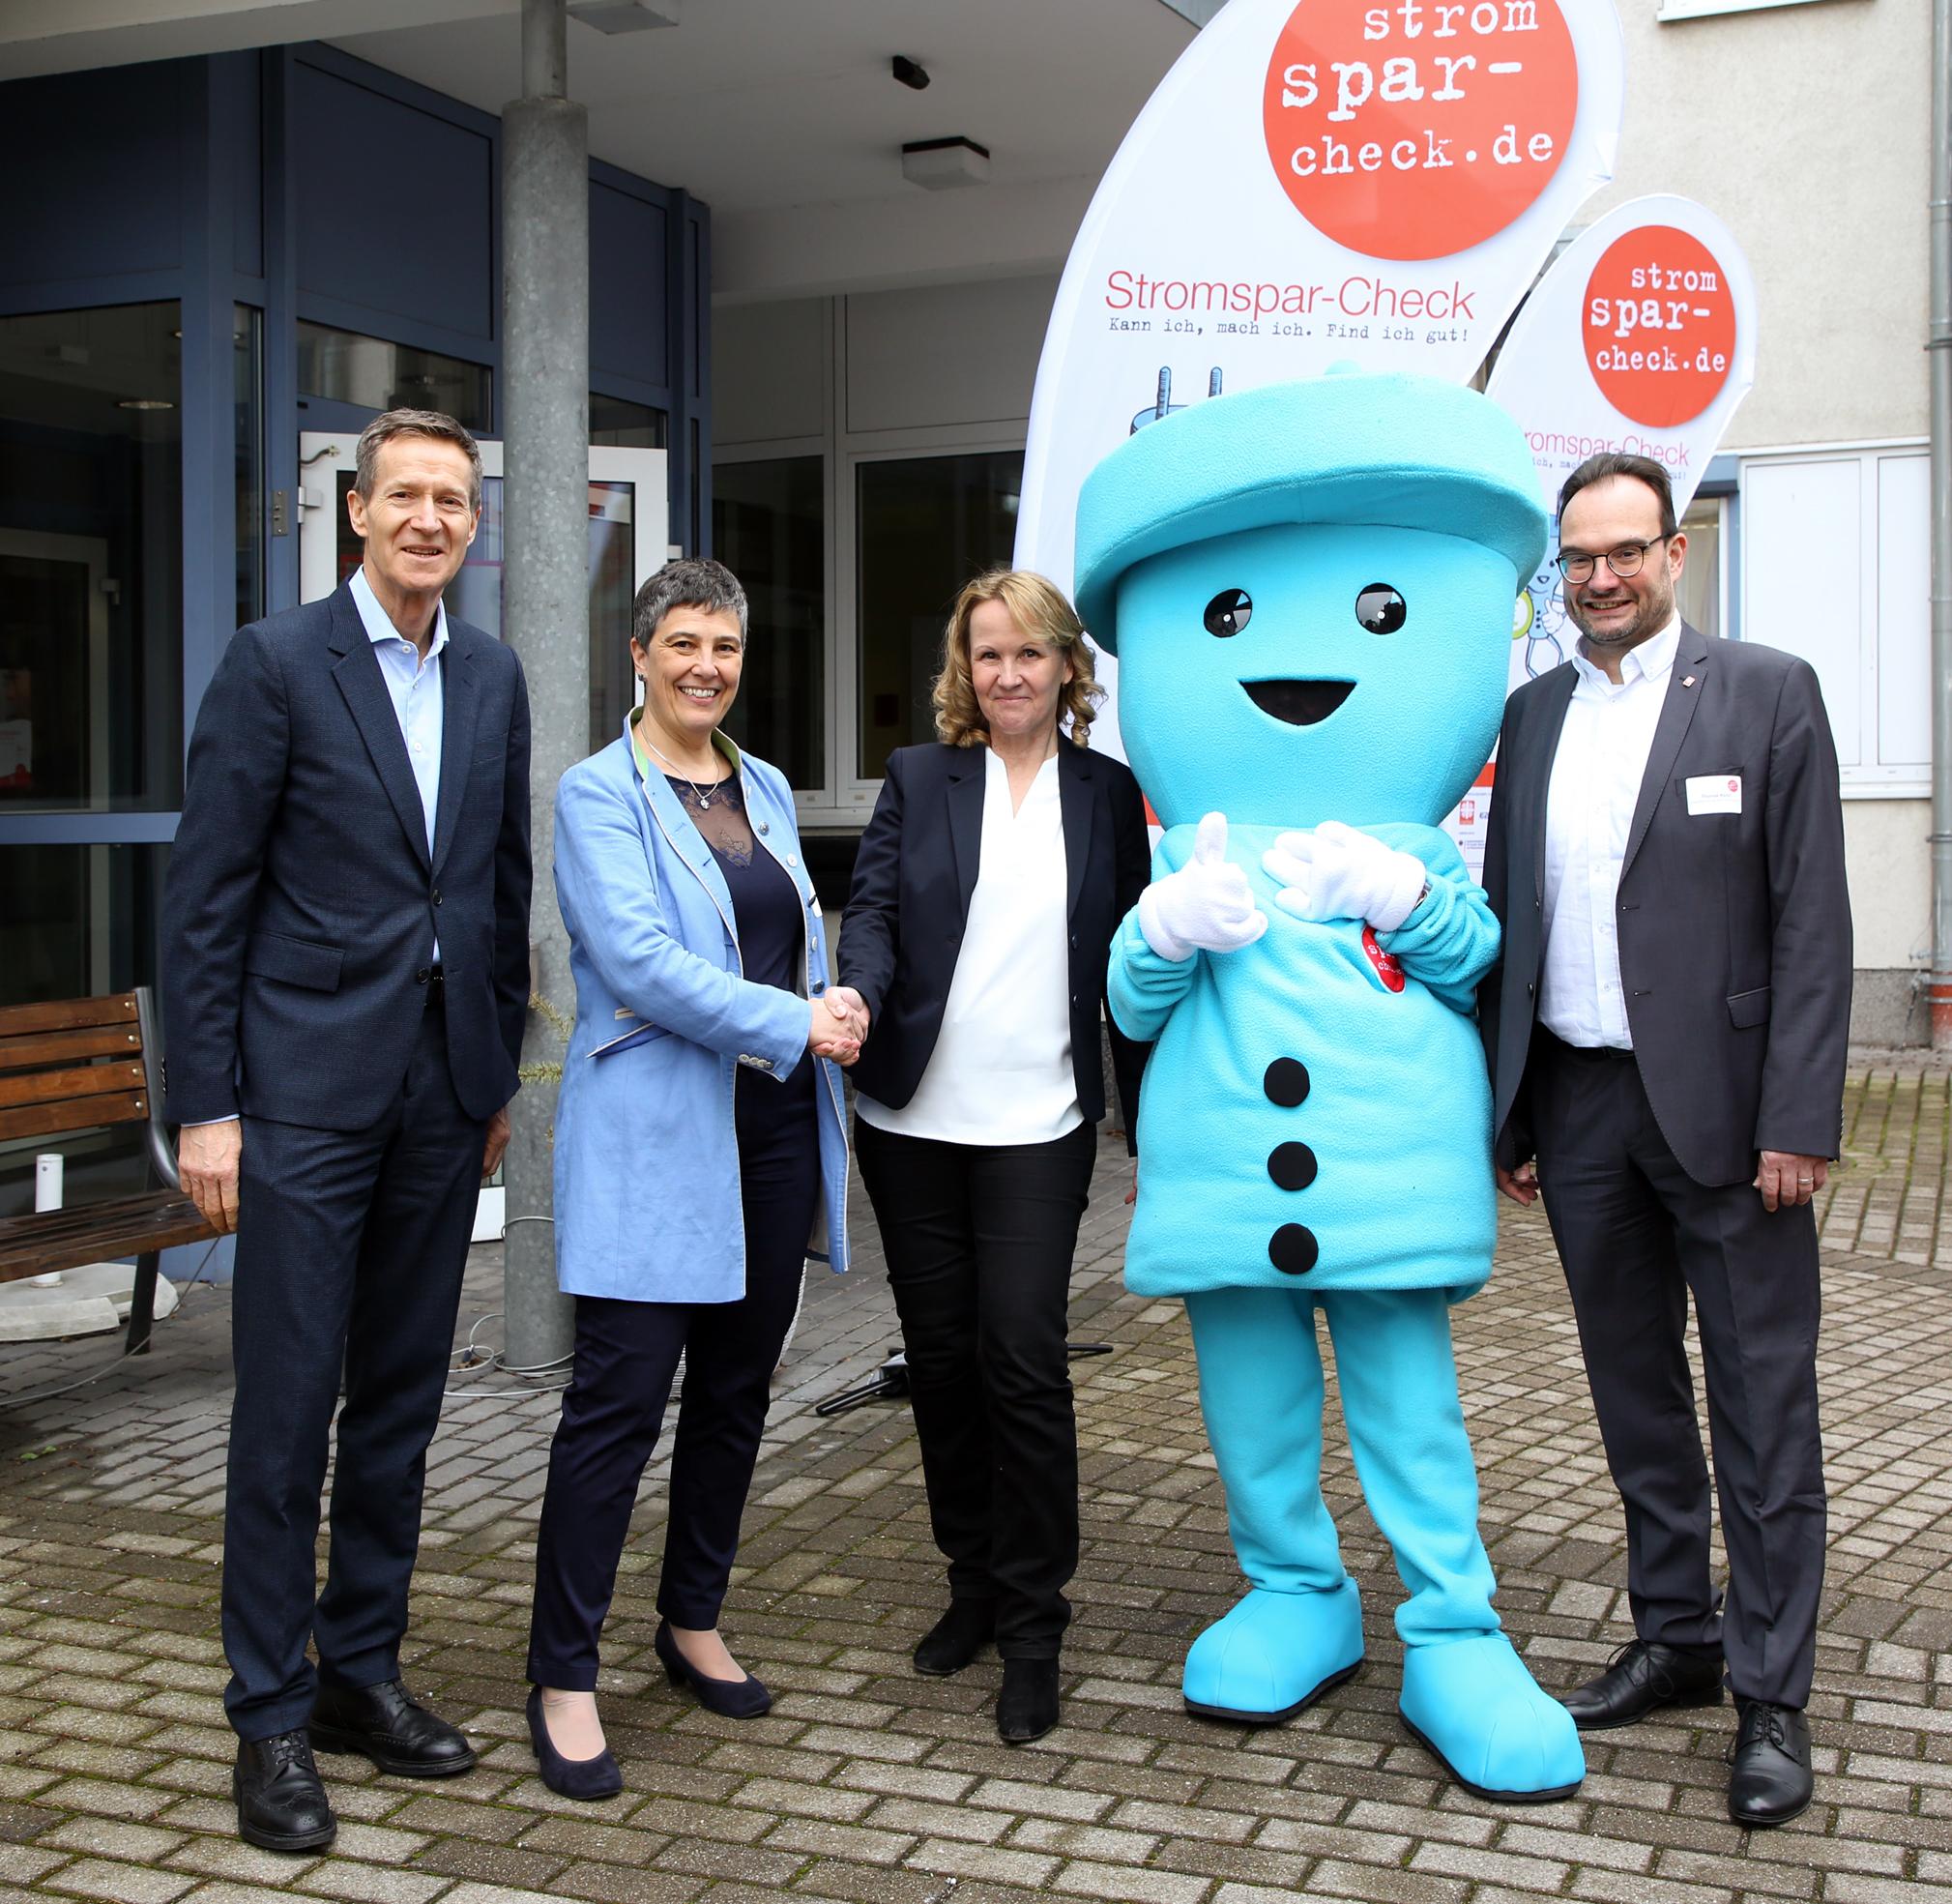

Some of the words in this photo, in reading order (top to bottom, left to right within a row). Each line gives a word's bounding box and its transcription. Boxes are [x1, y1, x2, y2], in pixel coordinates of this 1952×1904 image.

[1363, 0, 1539, 41] strom
[1282, 54, 1523, 122] spar-
[1290, 124, 1554, 177] check.de
[1105, 270, 1476, 322] Stromspar-Check
[1631, 261, 1718, 292] strom
[1108, 316, 1151, 333] Kann
[1163, 318, 1203, 336] ich,
[1216, 320, 1260, 335] mach
[1272, 322, 1312, 337] ich.
[1326, 323, 1369, 339] Find
[1383, 326, 1413, 341] ich
[1426, 327, 1469, 344] gut!
[1590, 297, 1710, 338] spar-
[1595, 344, 1726, 372] check.de
